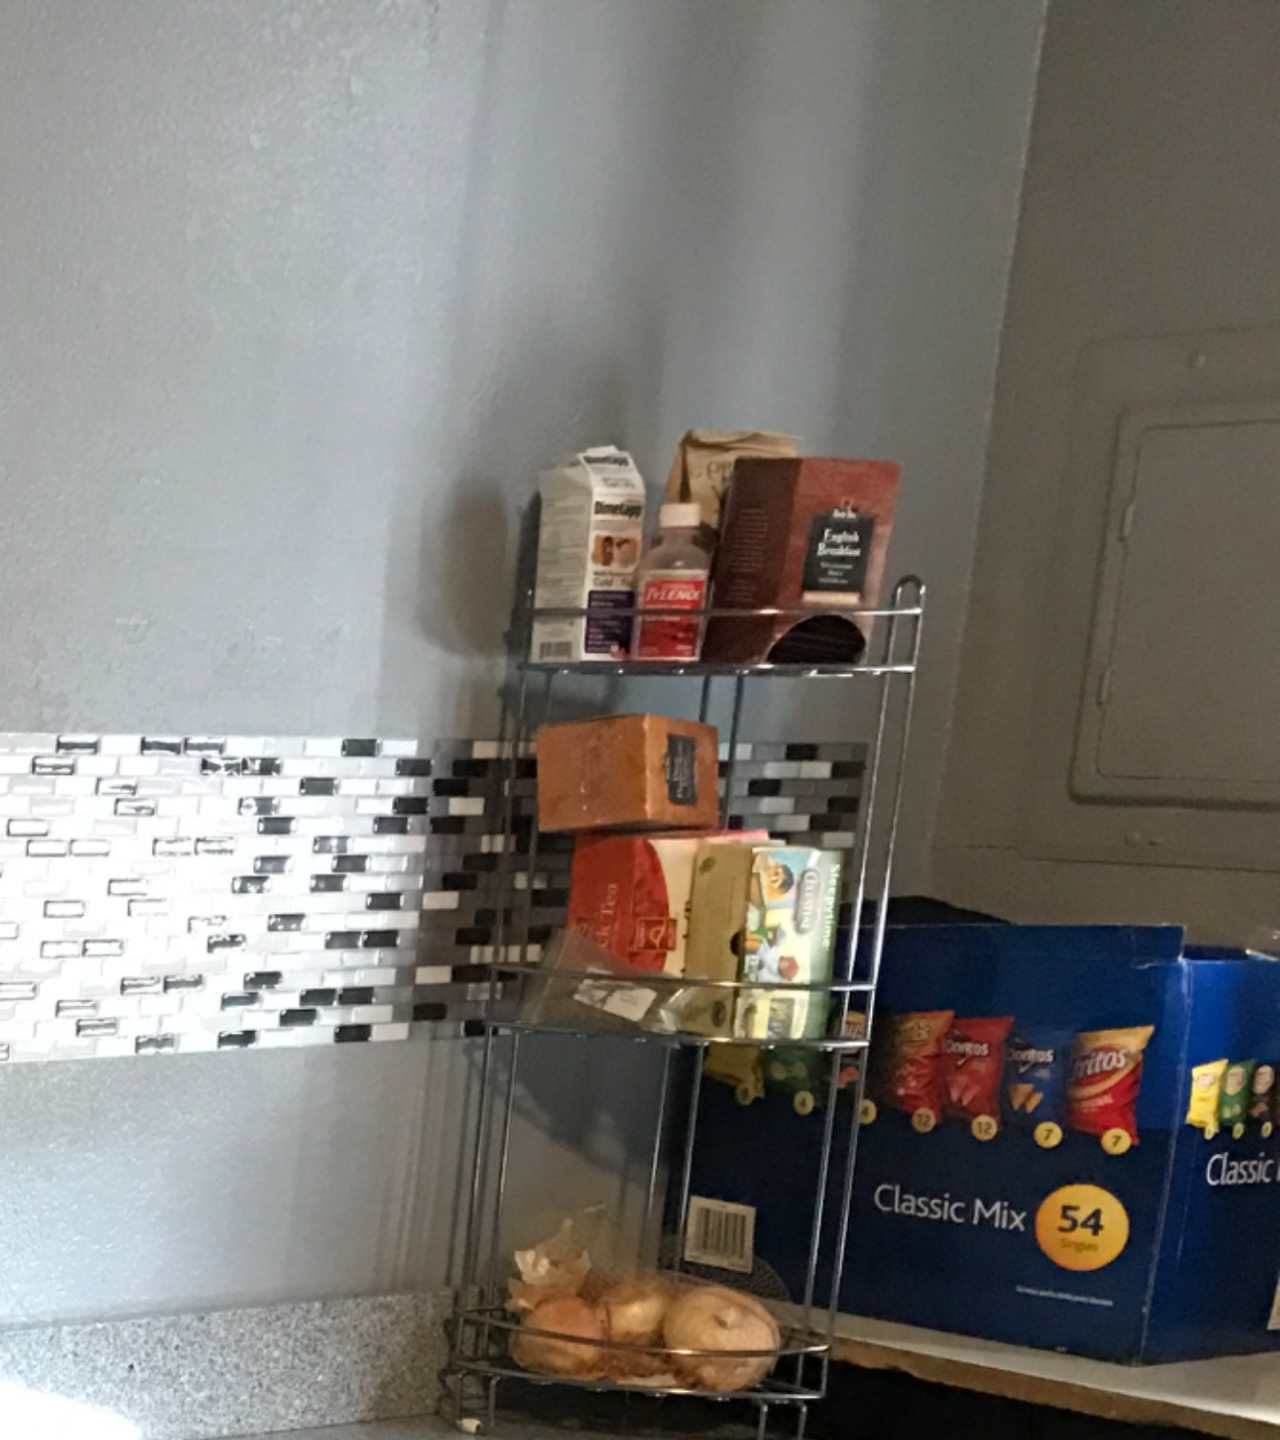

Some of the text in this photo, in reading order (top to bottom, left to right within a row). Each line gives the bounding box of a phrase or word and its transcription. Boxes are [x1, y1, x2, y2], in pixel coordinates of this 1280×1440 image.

[594, 501, 642, 518] Dimetapp
[824, 528, 859, 544] English
[822, 863, 841, 950] Sleepytime
[943, 1039, 990, 1057] Doritos
[976, 1121, 992, 1135] 12
[1043, 1129, 1053, 1141] 7
[1111, 1135, 1122, 1148] 7
[1206, 1151, 1275, 1187] Classic
[874, 1183, 1027, 1232] Classic Mix
[1057, 1205, 1104, 1237] 54
